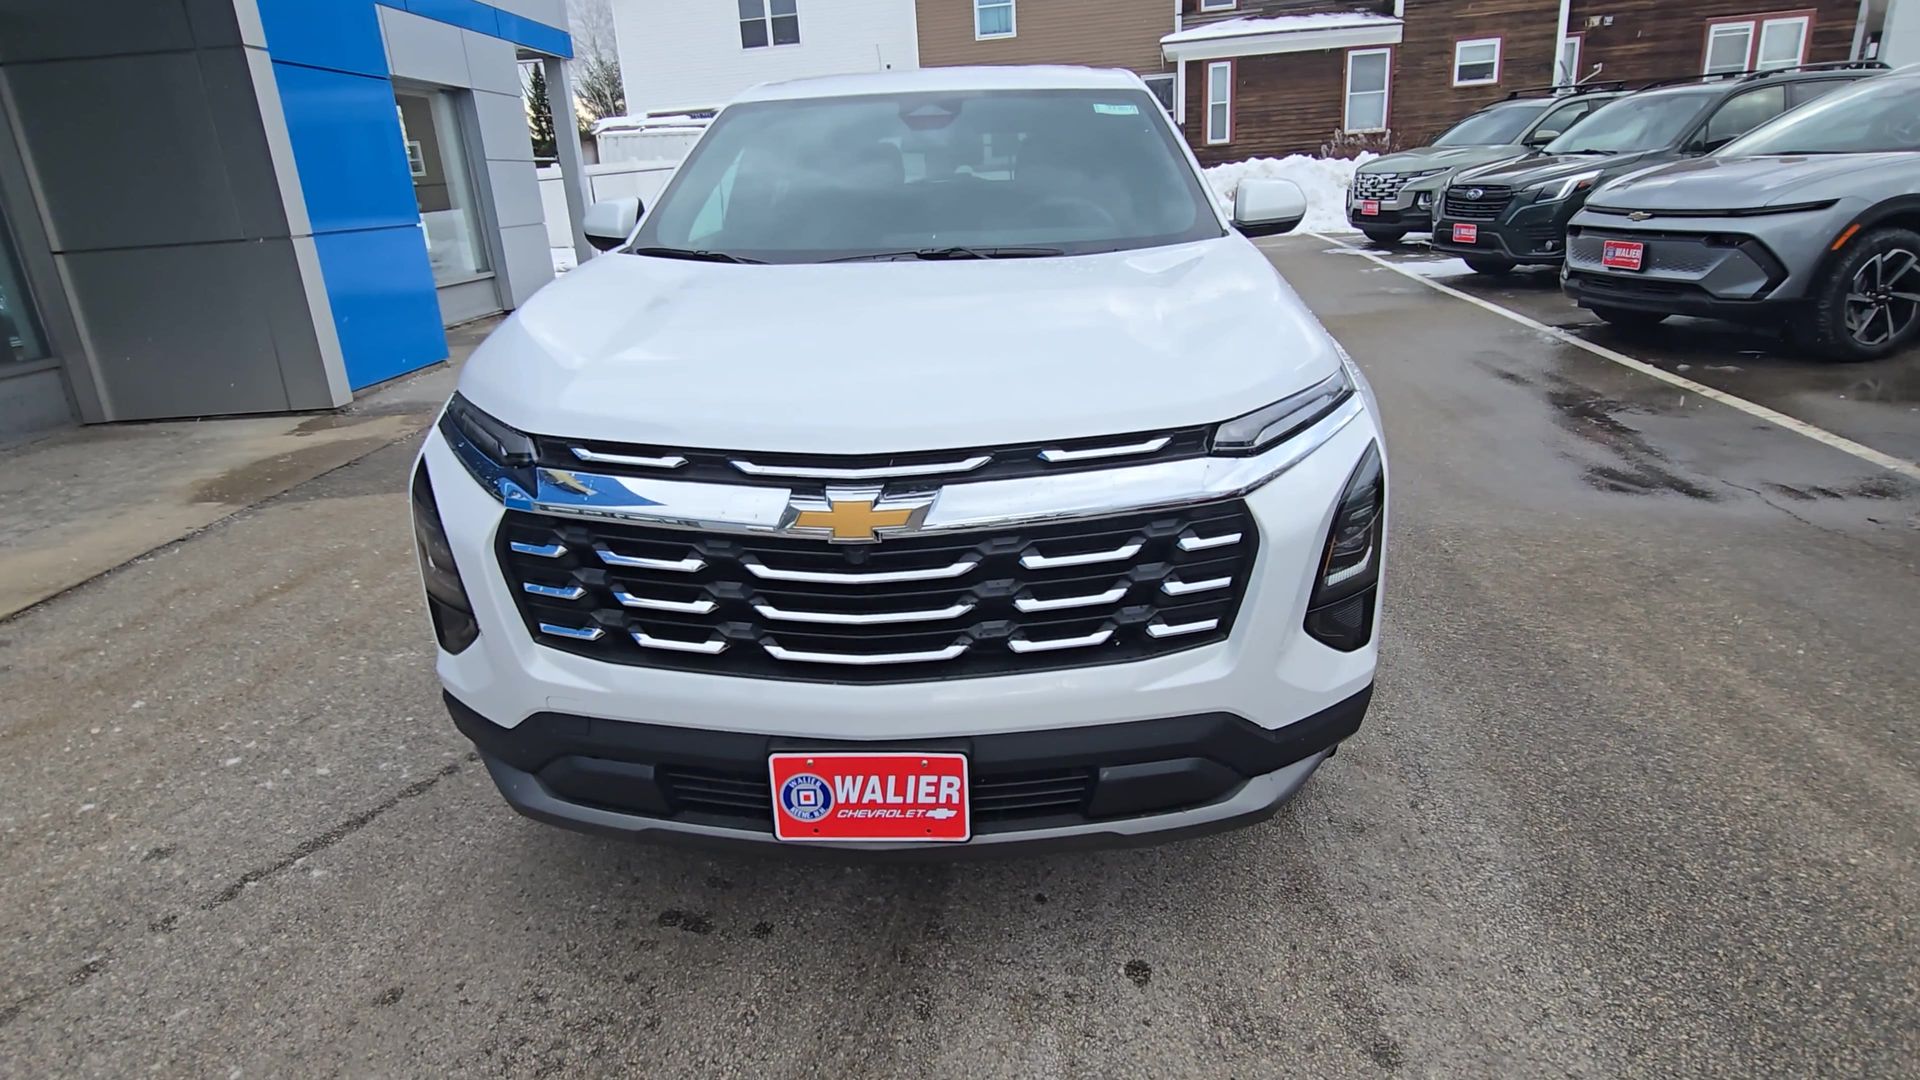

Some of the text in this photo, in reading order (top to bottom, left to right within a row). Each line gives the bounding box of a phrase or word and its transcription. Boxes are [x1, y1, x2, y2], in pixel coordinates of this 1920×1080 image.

[788, 775, 822, 788] WALIER
[834, 775, 960, 804] WALIER
[837, 808, 924, 818] CHEVROLET
